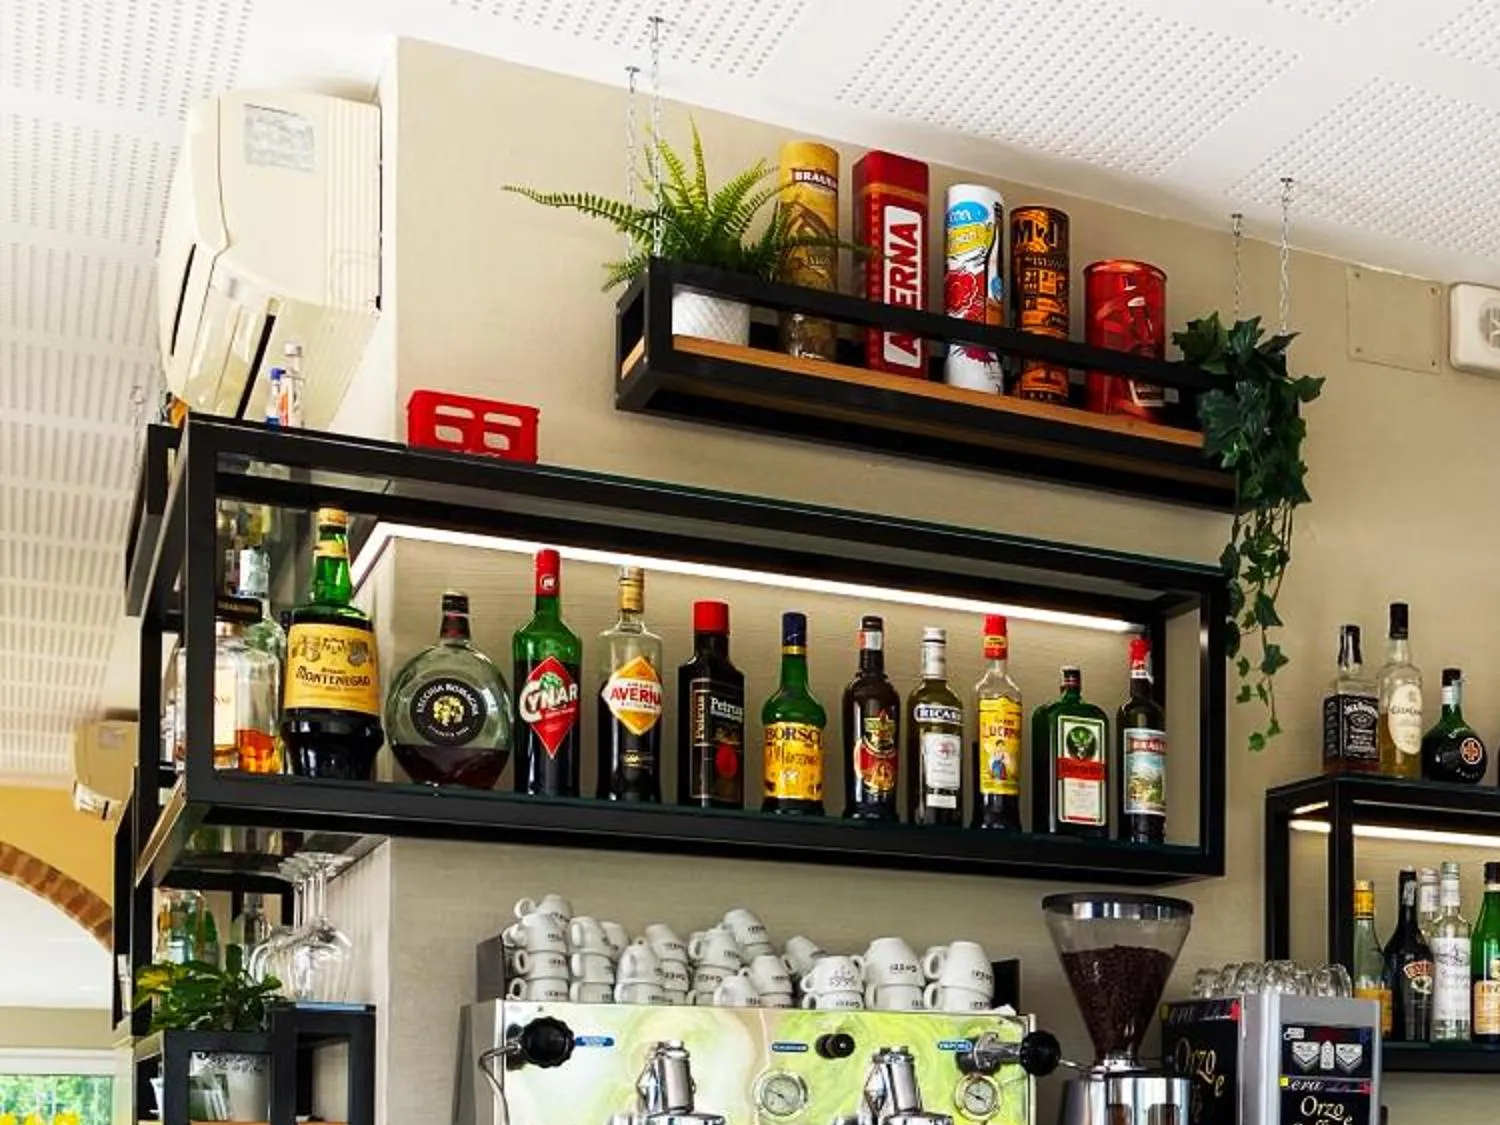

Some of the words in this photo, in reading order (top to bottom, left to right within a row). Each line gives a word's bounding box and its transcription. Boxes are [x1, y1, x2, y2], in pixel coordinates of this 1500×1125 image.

[889, 222, 919, 357] AERNA
[519, 682, 579, 723] CYNAR
[1300, 1096, 1346, 1121] Orzo
